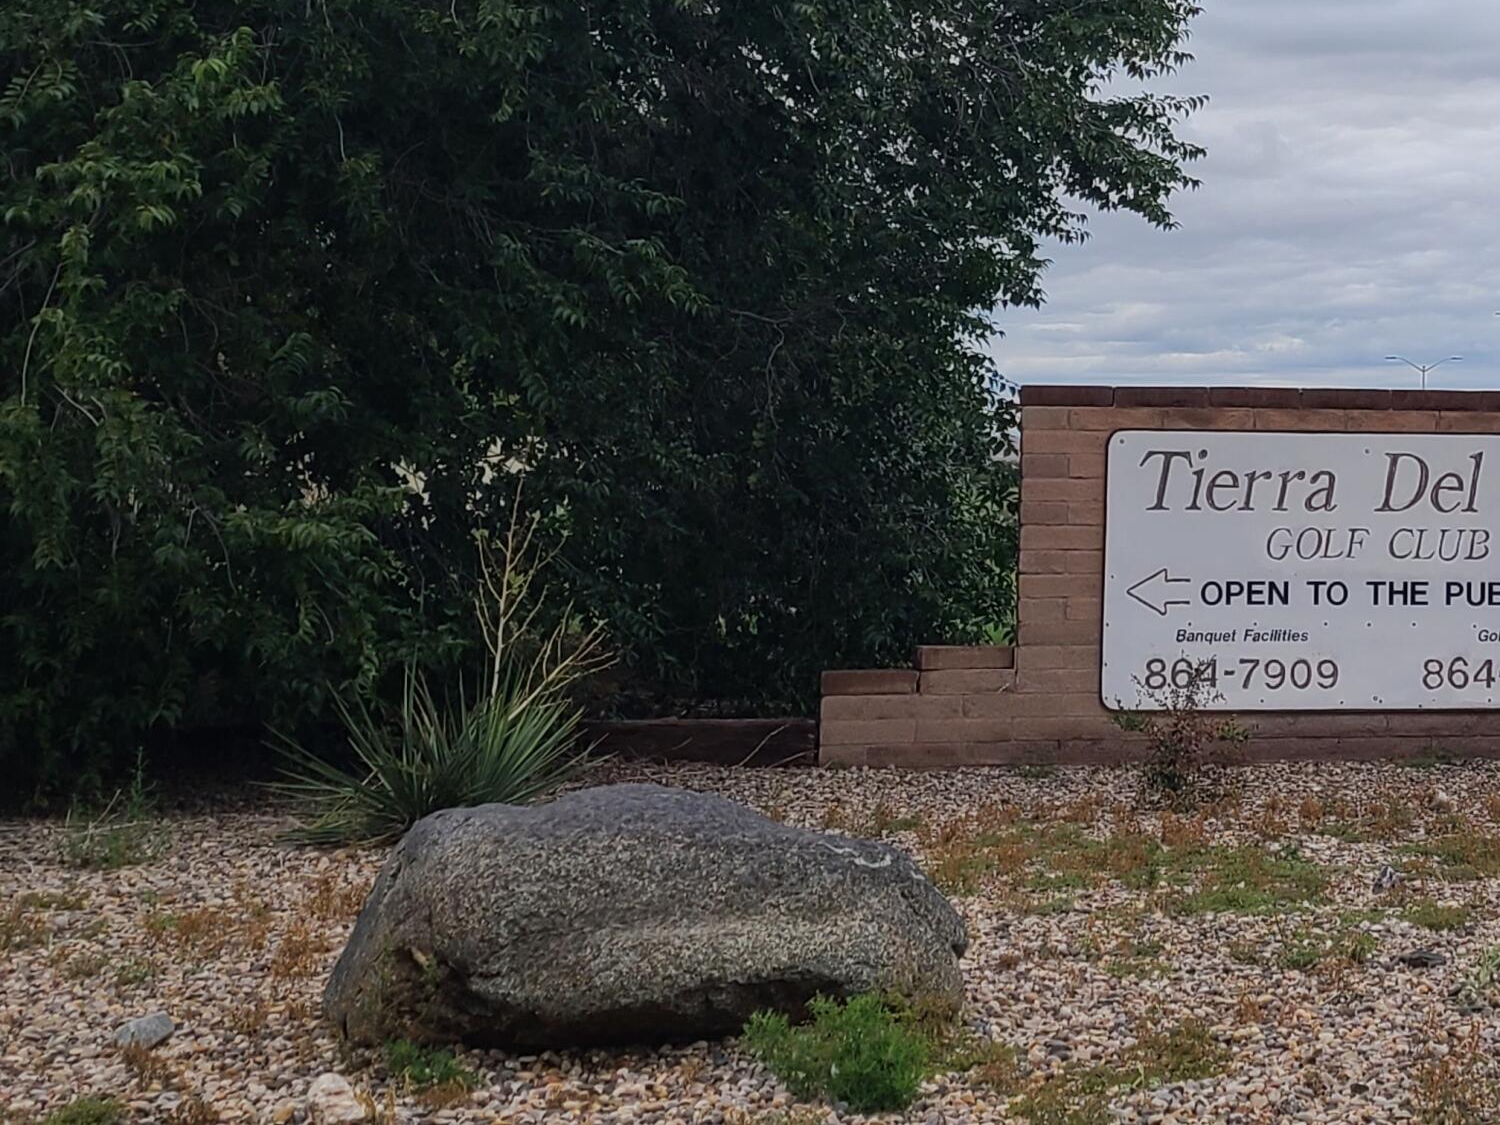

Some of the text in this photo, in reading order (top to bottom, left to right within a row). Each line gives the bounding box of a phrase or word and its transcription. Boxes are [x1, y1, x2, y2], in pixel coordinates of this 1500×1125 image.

[1139, 448, 1337, 513] Tierra
[1374, 450, 1484, 514] Del
[1266, 527, 1490, 561] GOLF CLUB
[1200, 581, 1290, 606] OPEN
[1306, 581, 1348, 606] TO
[1366, 581, 1429, 606] THE
[1176, 629, 1309, 644] Banquet Facilities
[1145, 658, 1339, 690] 864-7909
